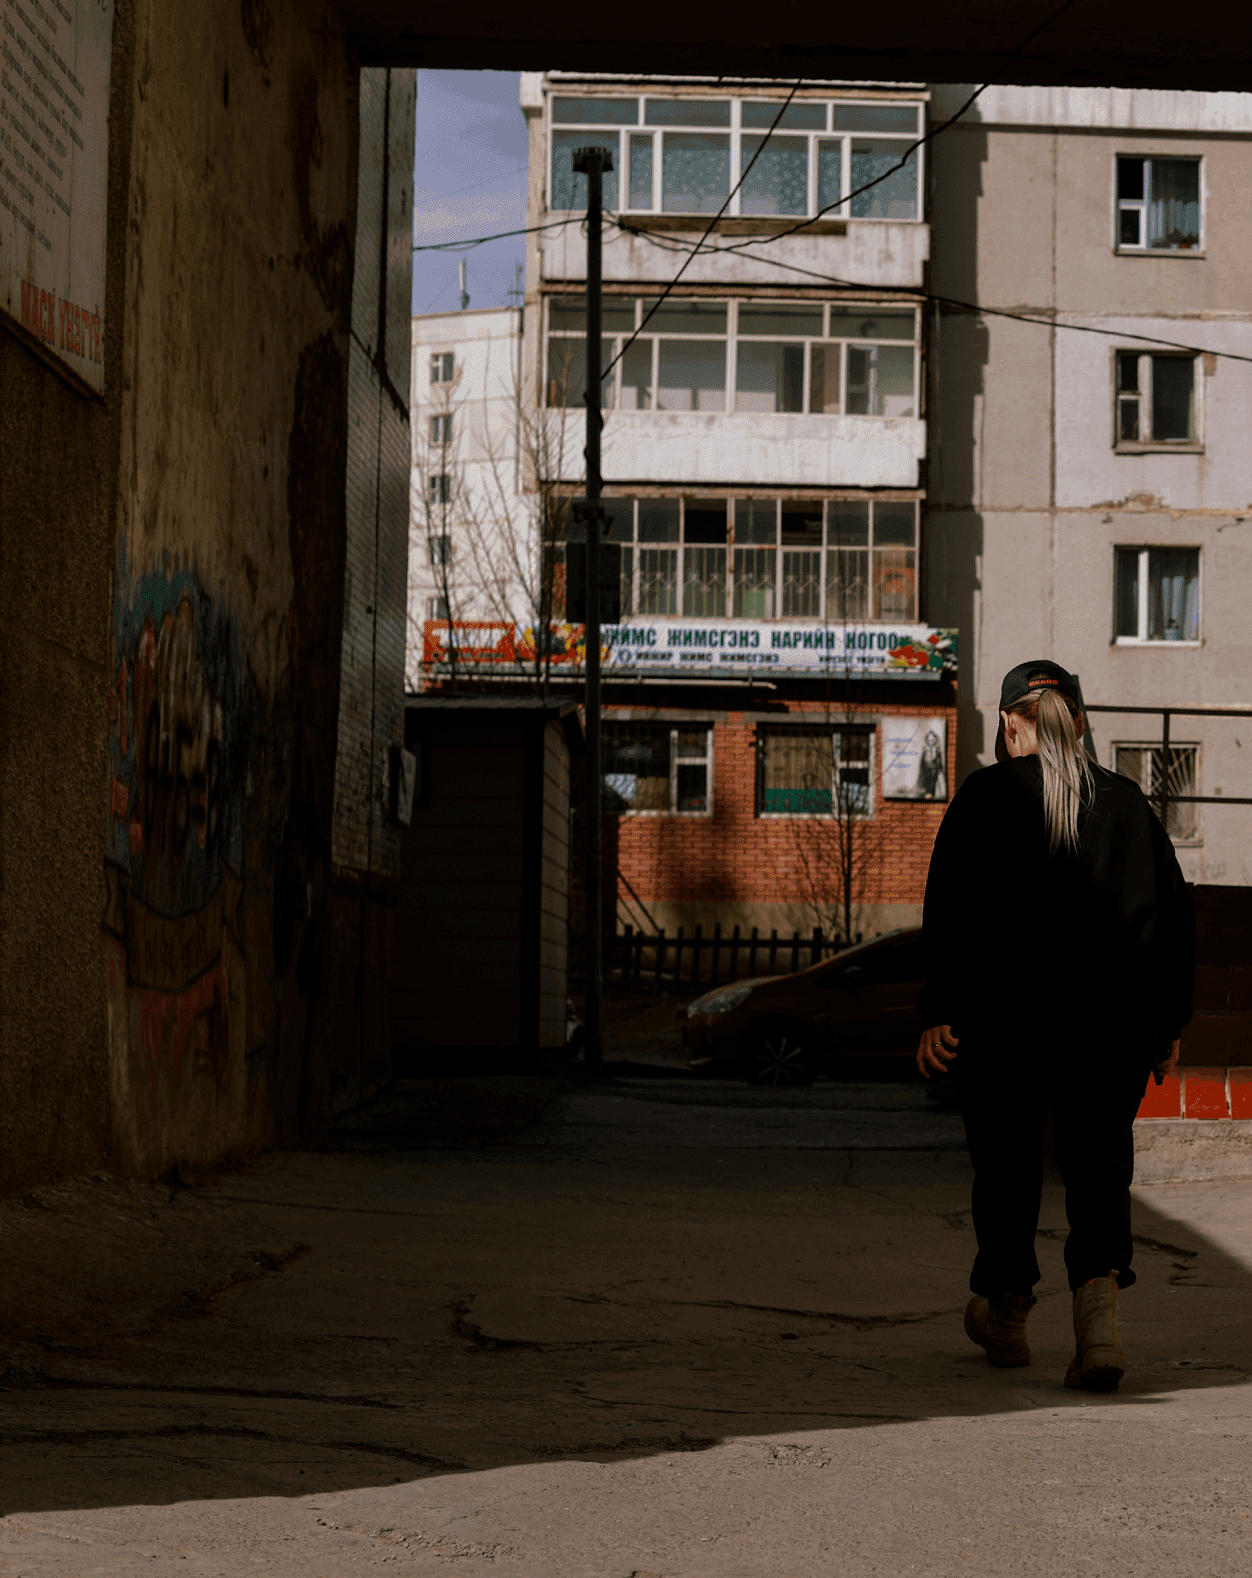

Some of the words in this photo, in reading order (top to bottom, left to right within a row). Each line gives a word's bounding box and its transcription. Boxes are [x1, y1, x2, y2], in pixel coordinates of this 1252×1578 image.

[667, 628, 760, 649] ЖИМСГЭНЭ
[771, 627, 835, 650] НАРИЙН
[846, 629, 899, 650] НОГОО
